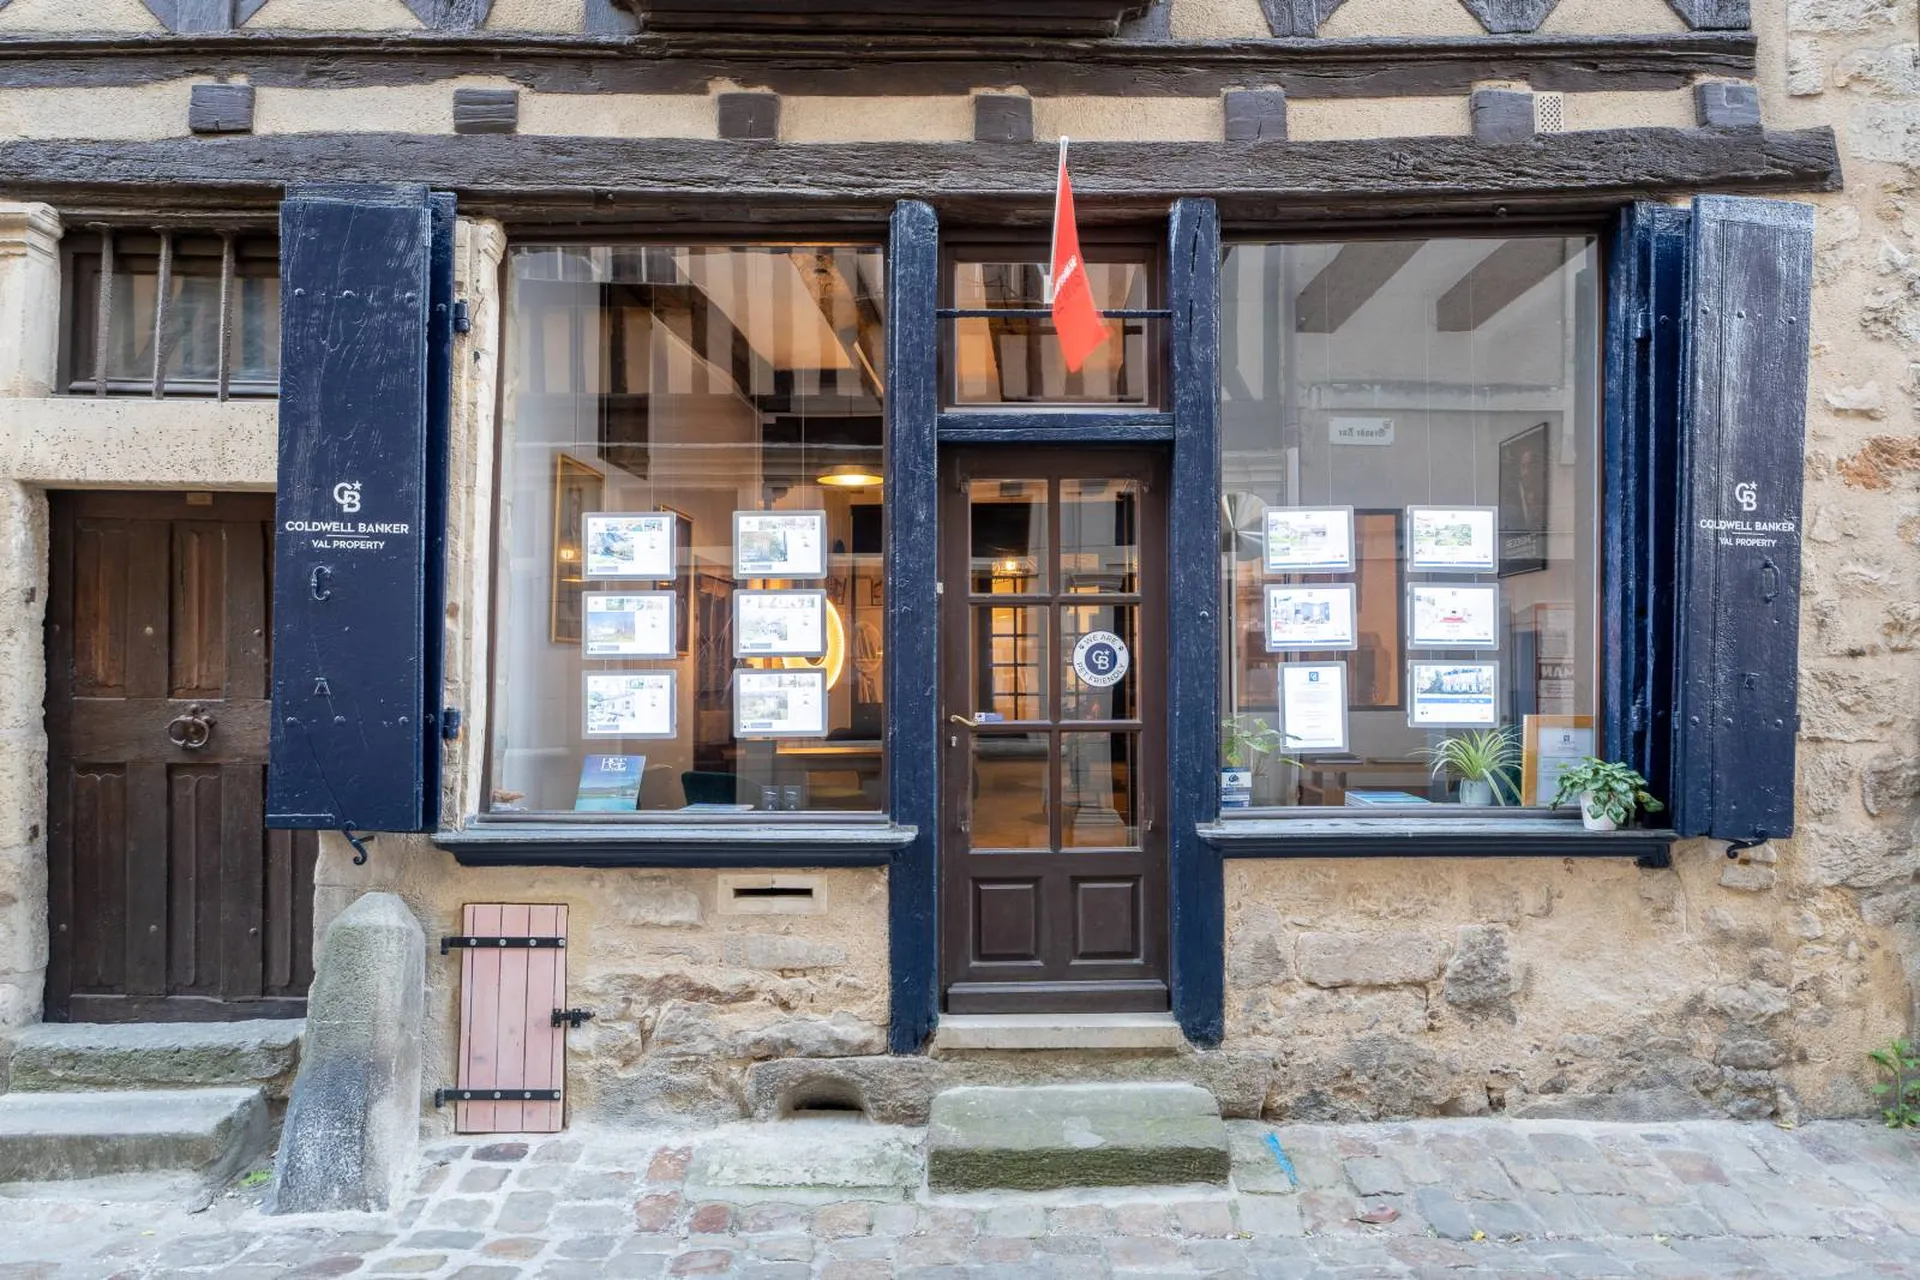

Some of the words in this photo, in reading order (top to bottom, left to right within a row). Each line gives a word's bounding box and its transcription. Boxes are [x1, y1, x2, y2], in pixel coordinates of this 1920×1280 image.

[285, 521, 355, 532] COLDWELL
[358, 522, 409, 534] BANKER
[1700, 519, 1752, 531] COLDWELL
[1755, 521, 1795, 532] BANKER
[312, 540, 330, 548] VAL
[333, 540, 385, 549] PROPERTY
[1720, 537, 1733, 546] VAL
[1736, 539, 1777, 547] PROPERTY
[1083, 634, 1098, 645] WE
[1100, 634, 1118, 644] ARE
[1077, 661, 1089, 677] PET
[1089, 663, 1125, 684] FRIENDLY
